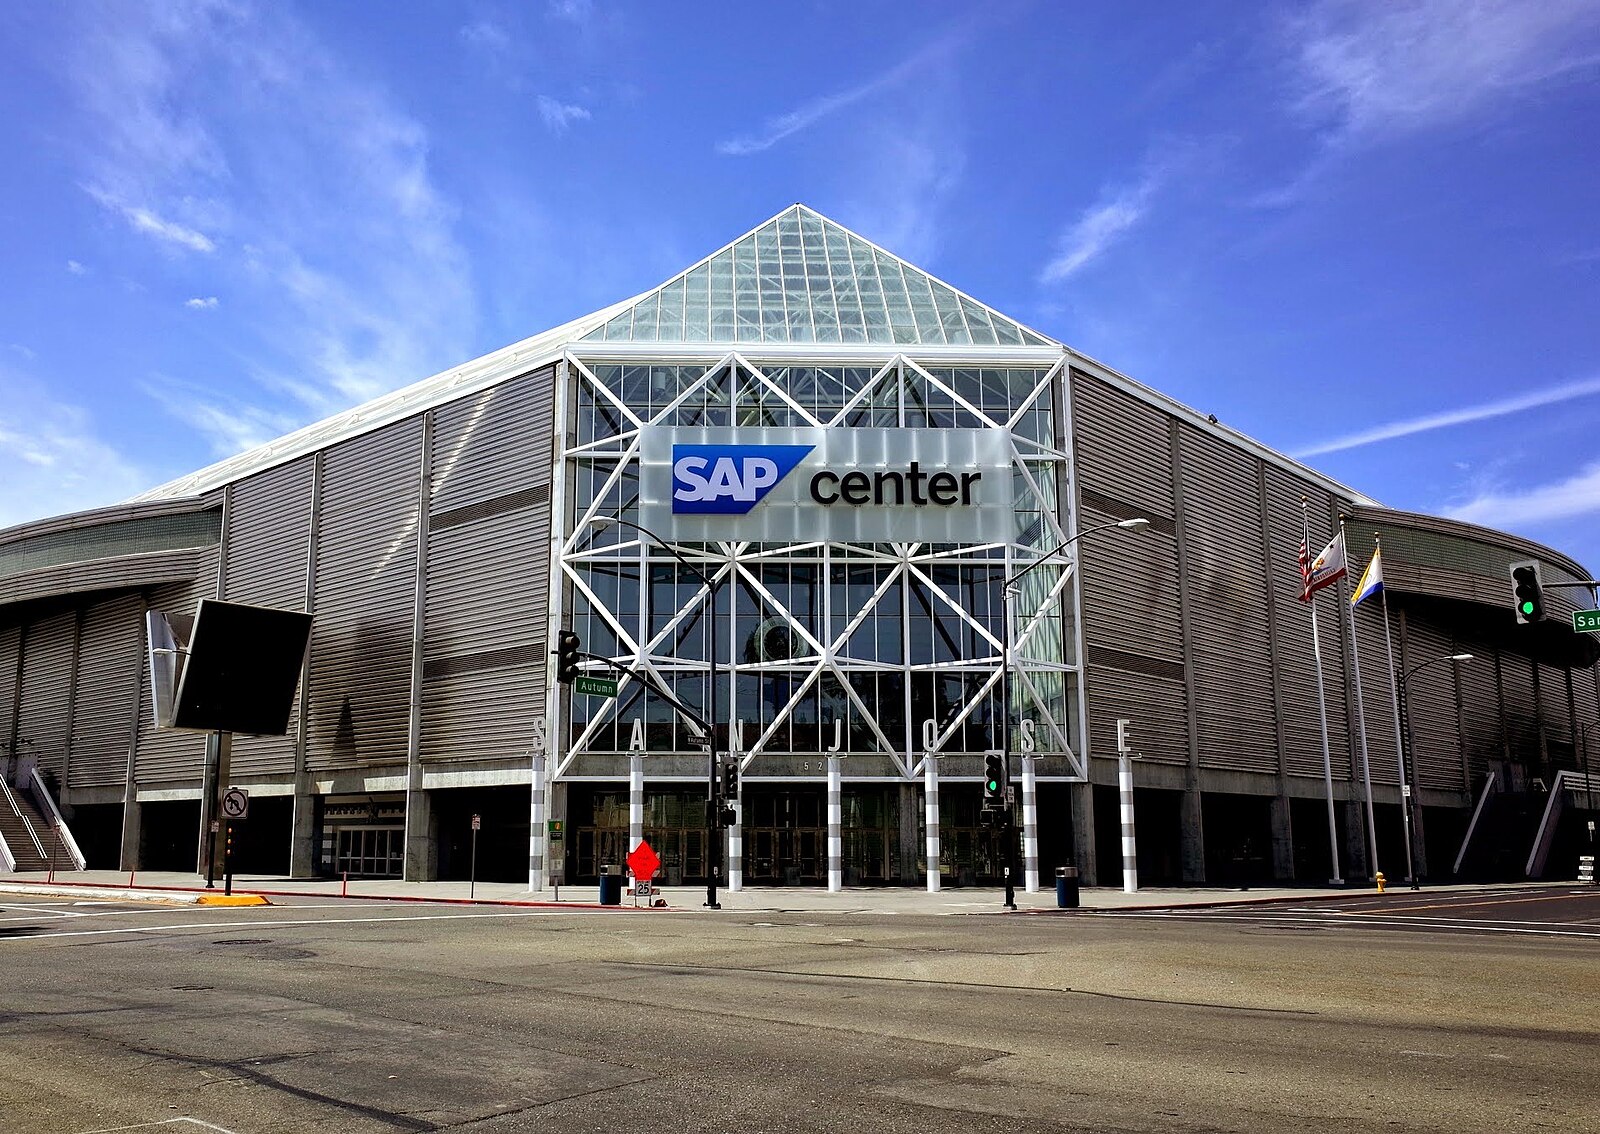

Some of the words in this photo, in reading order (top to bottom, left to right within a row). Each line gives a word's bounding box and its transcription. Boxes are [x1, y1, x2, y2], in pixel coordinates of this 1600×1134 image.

[674, 457, 778, 501] SAP
[810, 461, 981, 505] center
[581, 681, 613, 693] Autumn
[637, 884, 650, 895] 25
